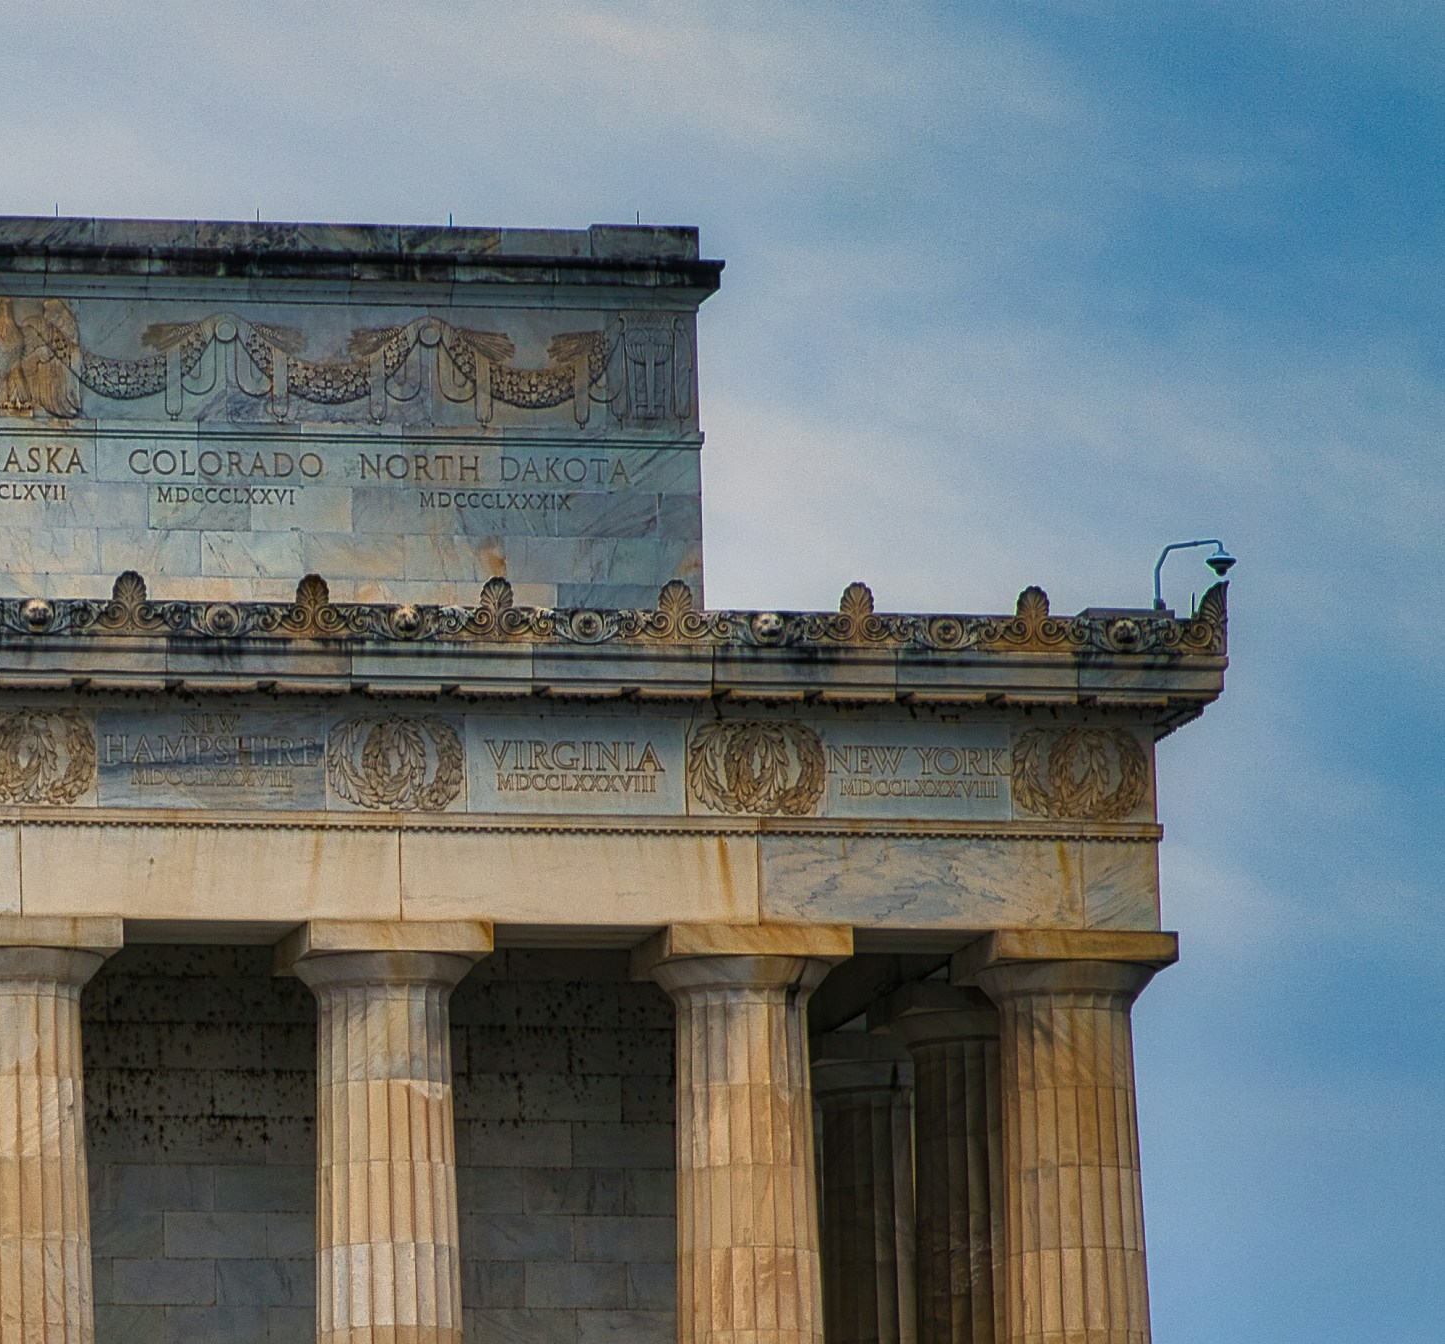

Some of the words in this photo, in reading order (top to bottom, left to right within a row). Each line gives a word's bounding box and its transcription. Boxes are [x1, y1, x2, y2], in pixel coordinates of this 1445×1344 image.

[128, 449, 324, 478] COLORADO
[360, 453, 480, 482] NORTH
[499, 456, 631, 485] DAKOTA
[157, 487, 295, 505] MDCCCLXXVI
[419, 491, 572, 510] MDCCCLXXXIX
[181, 713, 240, 733] NEW
[104, 734, 318, 766] HAMPSHIRE
[484, 739, 666, 772] VIRGINIA
[827, 745, 908, 775] NEW
[913, 746, 1011, 776] YORK
[130, 768, 293, 788] MDCCLXXXVIII
[496, 772, 657, 793] MDCCLXXXVIII
[840, 778, 999, 798] MDCCLXXXVIII
